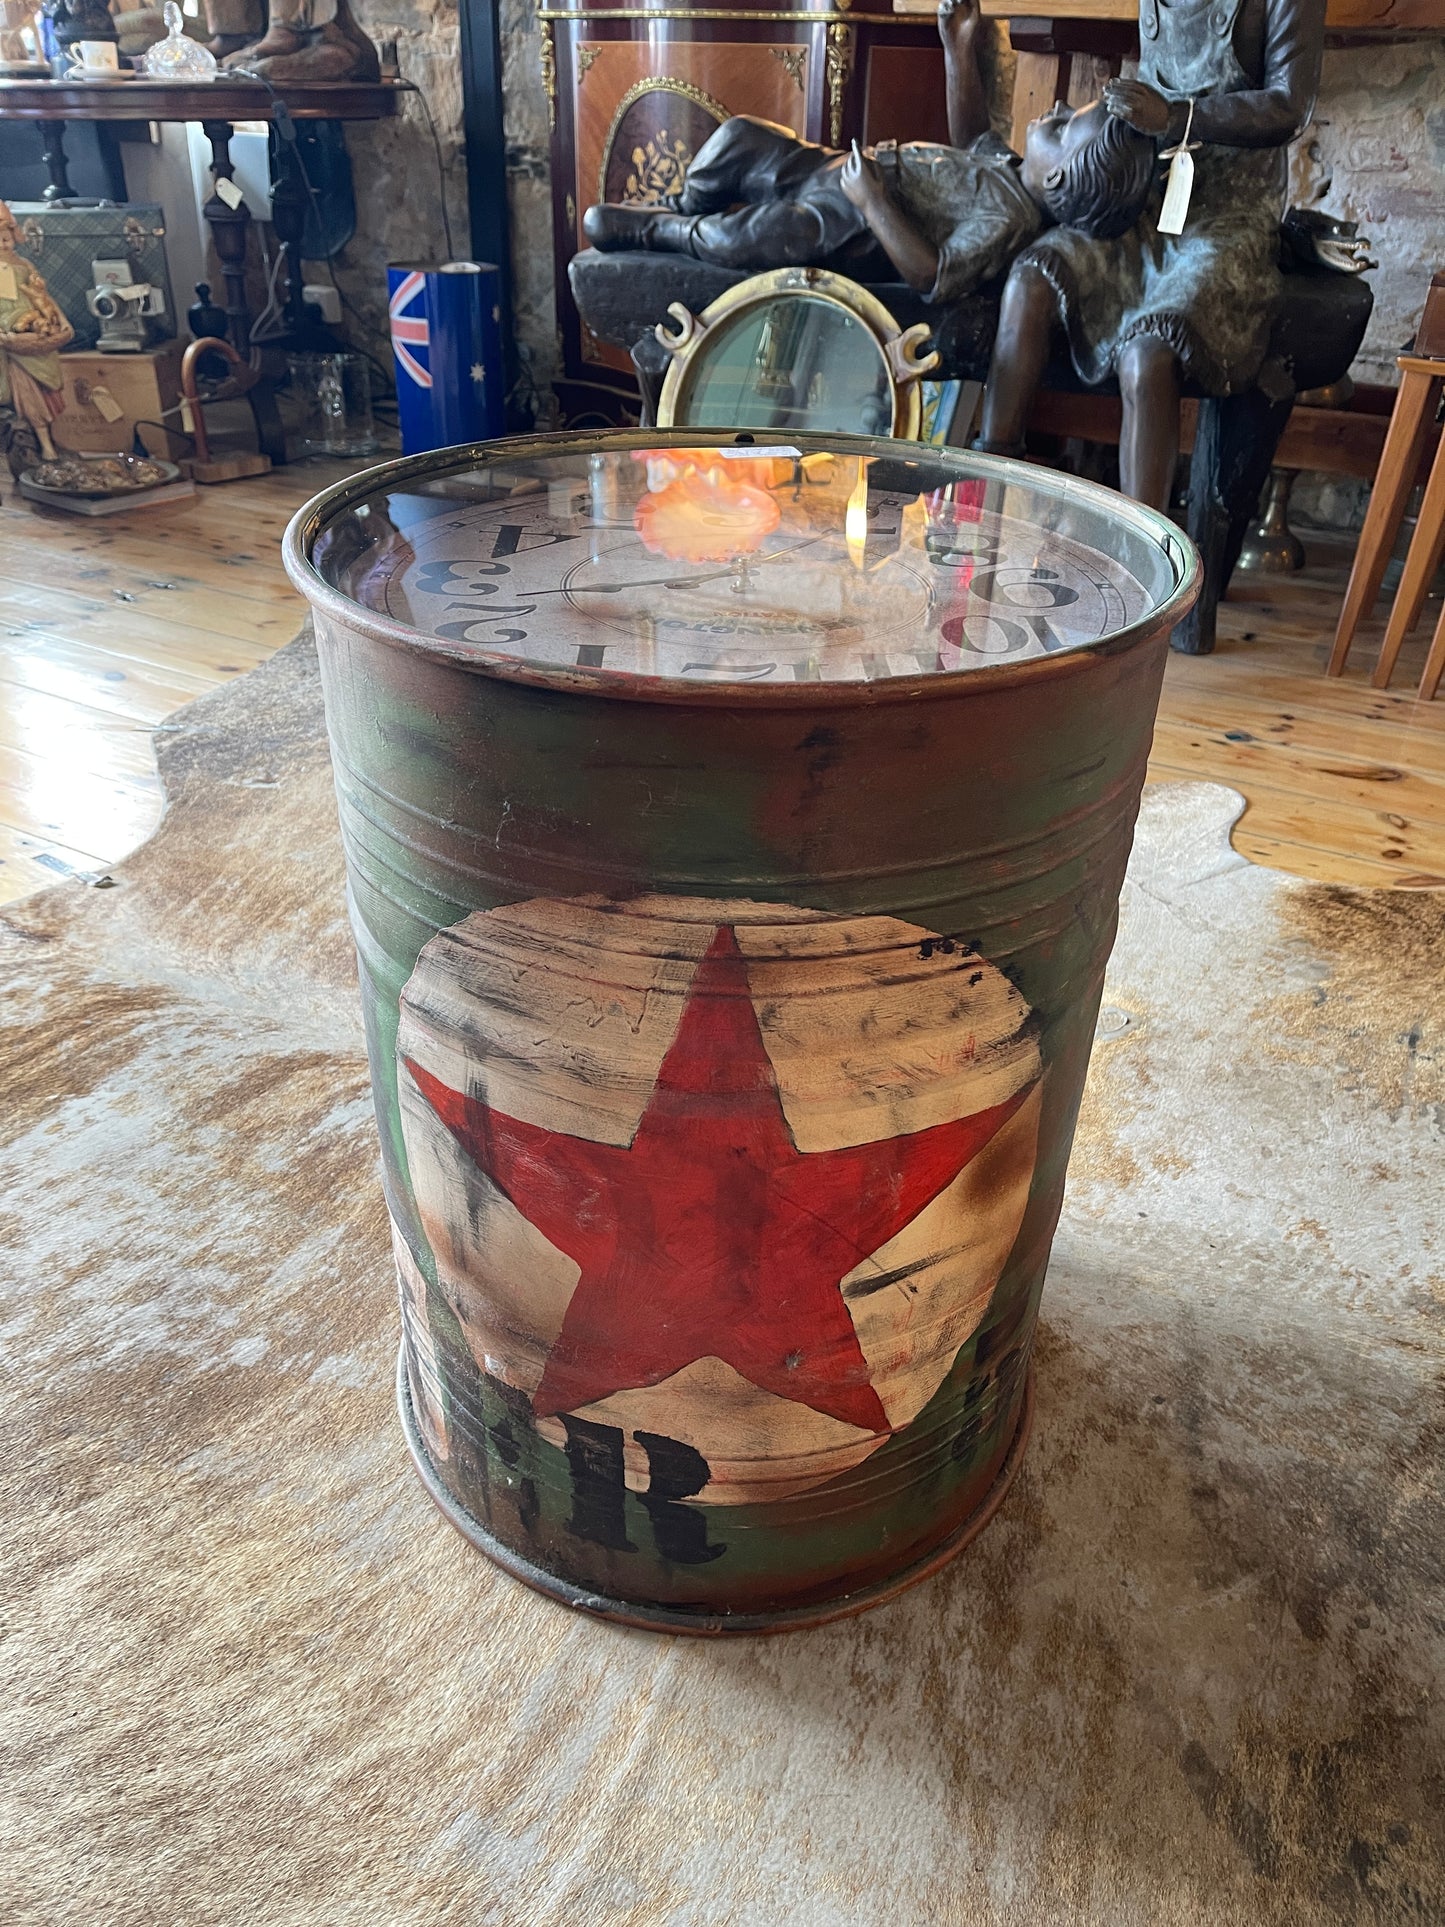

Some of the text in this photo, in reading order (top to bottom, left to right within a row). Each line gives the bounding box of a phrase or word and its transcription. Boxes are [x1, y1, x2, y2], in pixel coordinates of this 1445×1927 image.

[479, 523, 582, 559] 4
[909, 533, 1009, 567] 8
[415, 559, 512, 597] 3
[969, 567, 1080, 608] 9
[434, 601, 538, 644] 2
[940, 614, 1075, 654] 10
